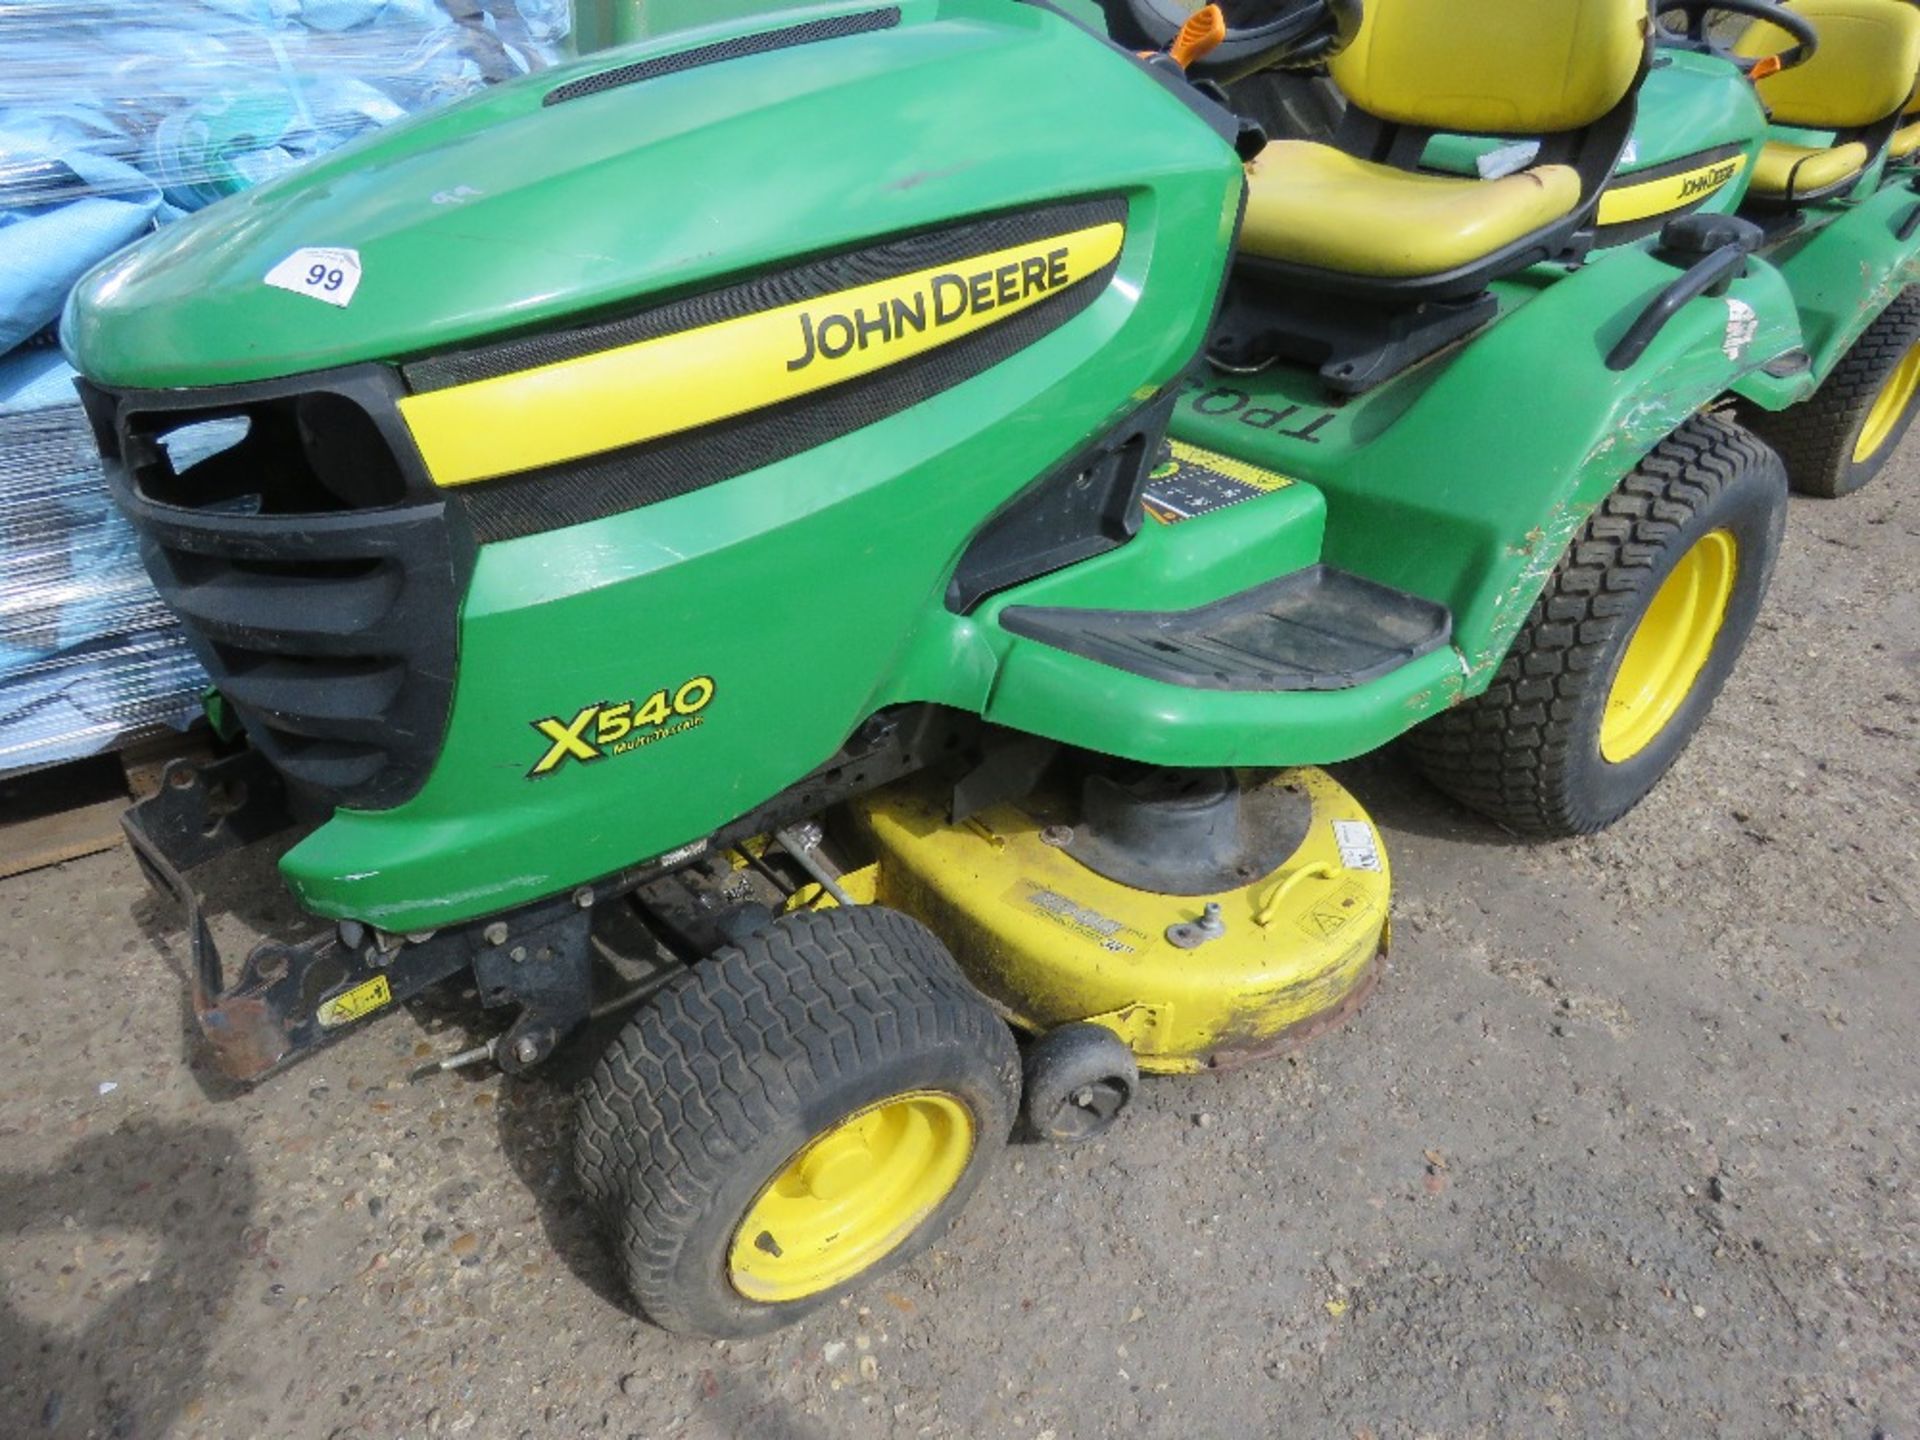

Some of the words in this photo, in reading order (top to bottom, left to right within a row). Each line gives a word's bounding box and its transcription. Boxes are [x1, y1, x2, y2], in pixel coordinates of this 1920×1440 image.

[305, 264, 344, 291] 99
[786, 291, 926, 372] JOHN
[931, 247, 1069, 327] DEERE
[525, 675, 716, 778] X540
